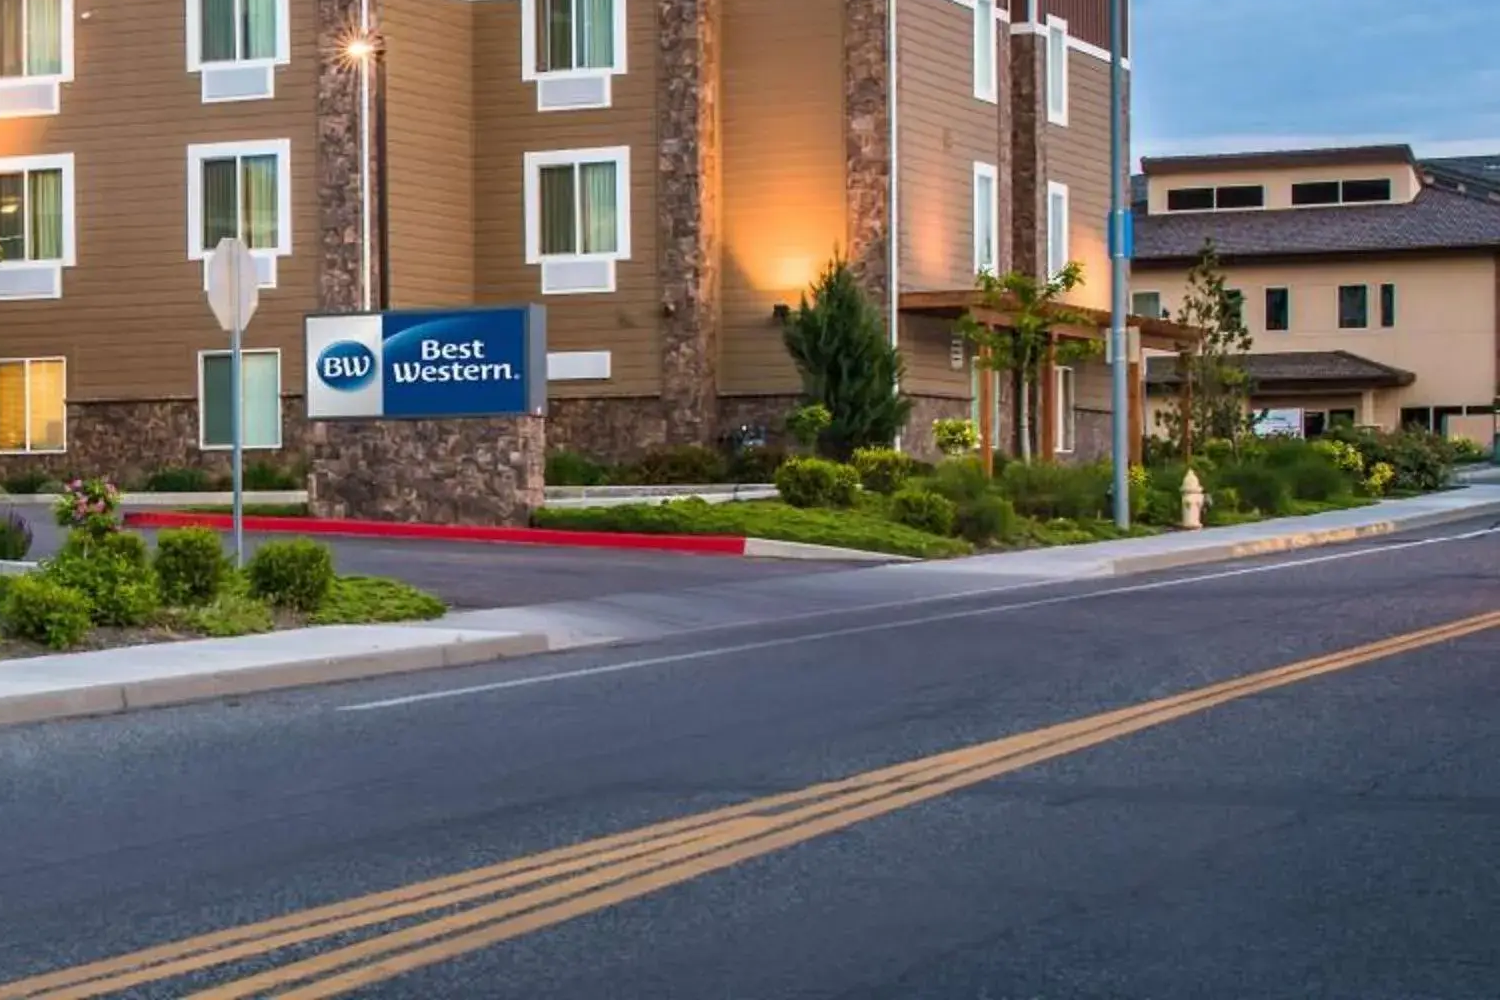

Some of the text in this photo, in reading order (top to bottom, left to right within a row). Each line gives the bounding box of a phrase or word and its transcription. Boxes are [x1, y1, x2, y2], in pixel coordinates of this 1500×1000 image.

[420, 339, 485, 361] Best
[323, 355, 371, 378] BW
[392, 362, 512, 384] Western
